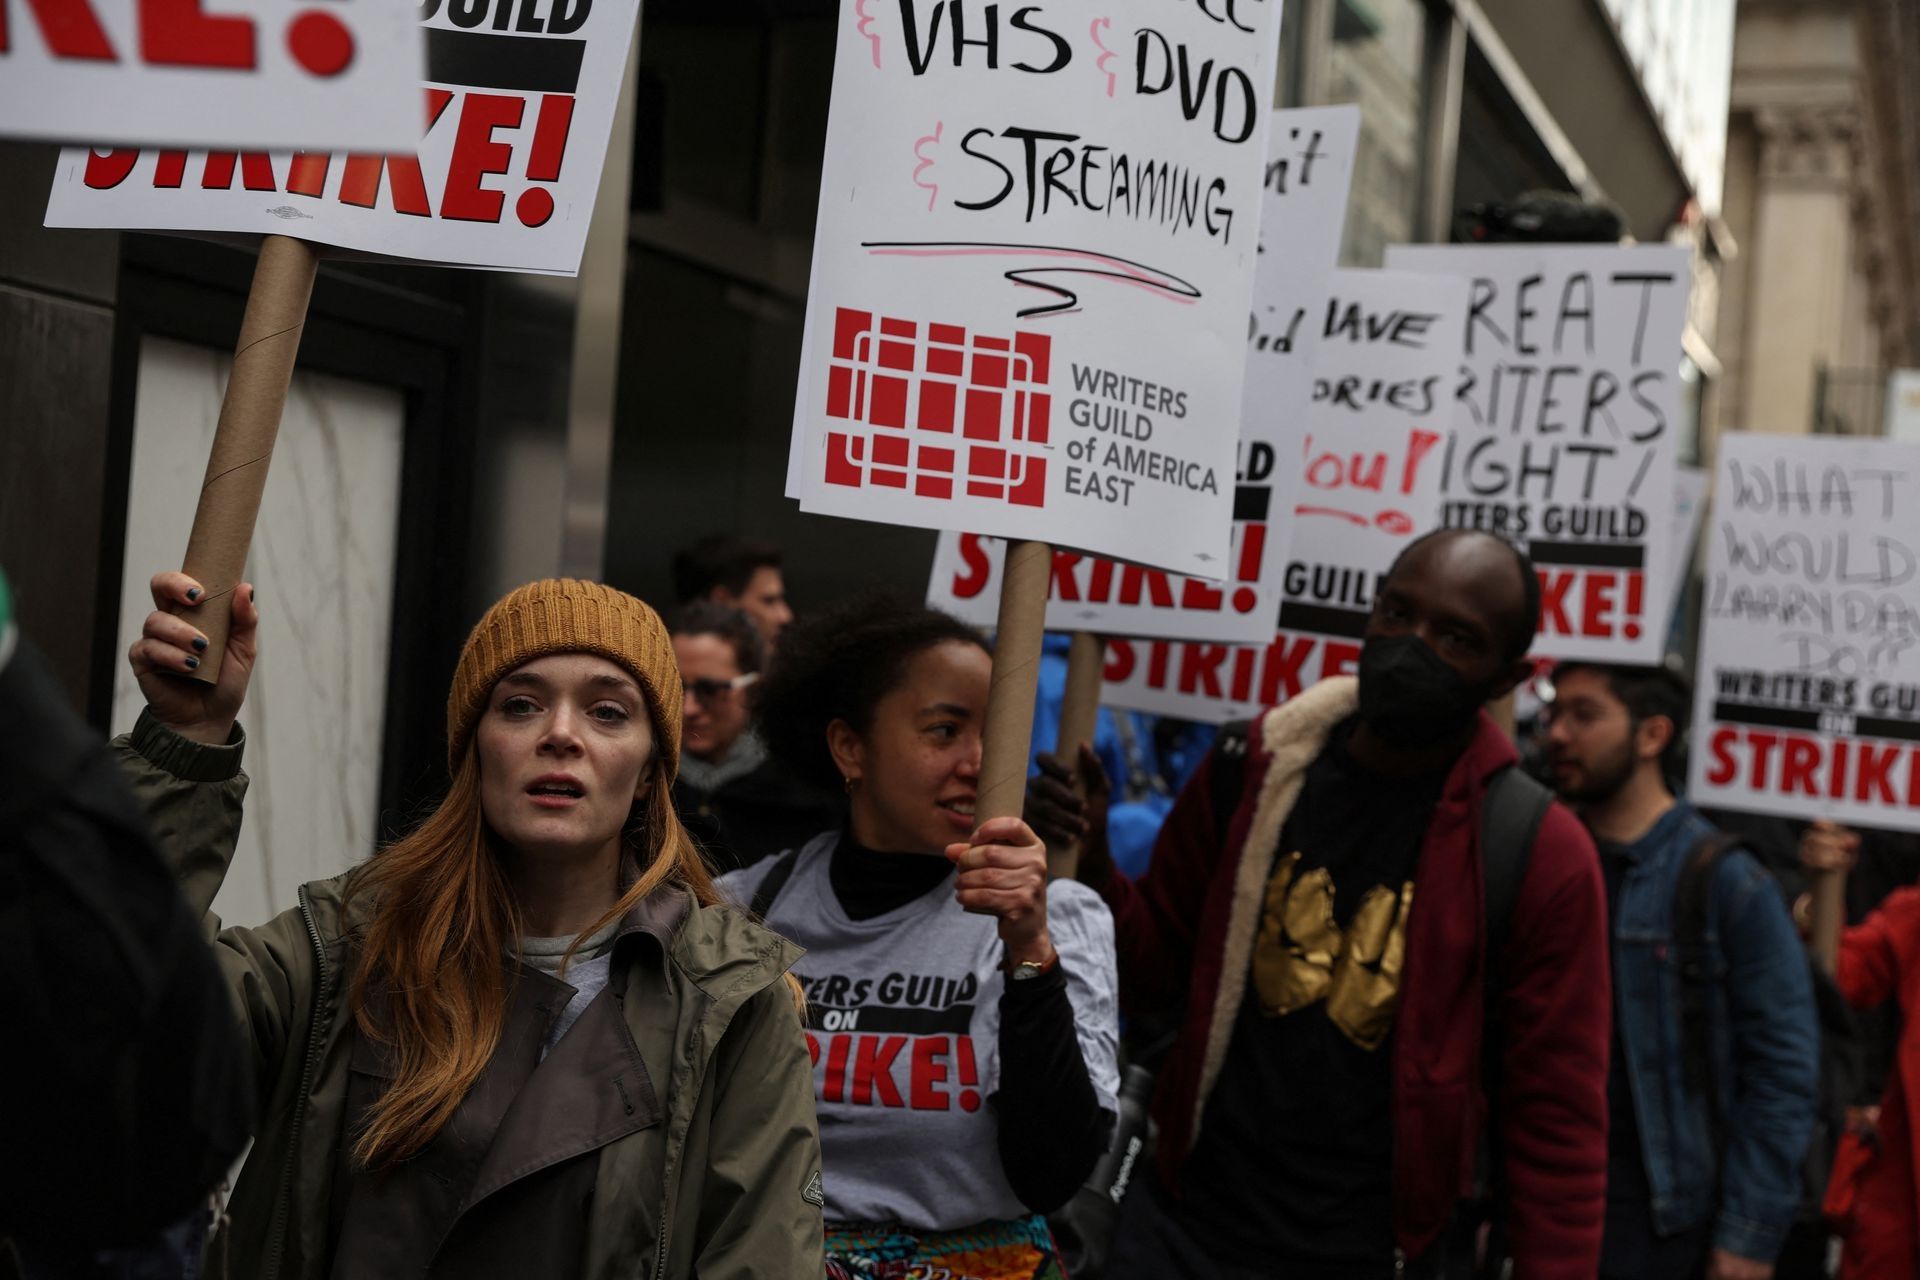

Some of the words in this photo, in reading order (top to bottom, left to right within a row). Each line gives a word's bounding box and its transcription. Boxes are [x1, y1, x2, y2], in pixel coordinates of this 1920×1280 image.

[900, 0, 1072, 76] VHS
[1134, 28, 1257, 144] DVD
[954, 126, 1234, 246] STREAMING
[1464, 271, 1675, 367] REAT
[1071, 363, 1188, 419] WRITERS
[1069, 399, 1153, 442] GUILD
[1064, 466, 1135, 507] EAST
[1066, 437, 1098, 463] of
[1102, 442, 1218, 496] AMERICA
[1728, 457, 1909, 521] WHAT
[1543, 505, 1647, 539] GUILD
[1722, 521, 1917, 584] WOULD
[1714, 668, 1858, 709] WRITERS
[822, 1009, 860, 1031] ON
